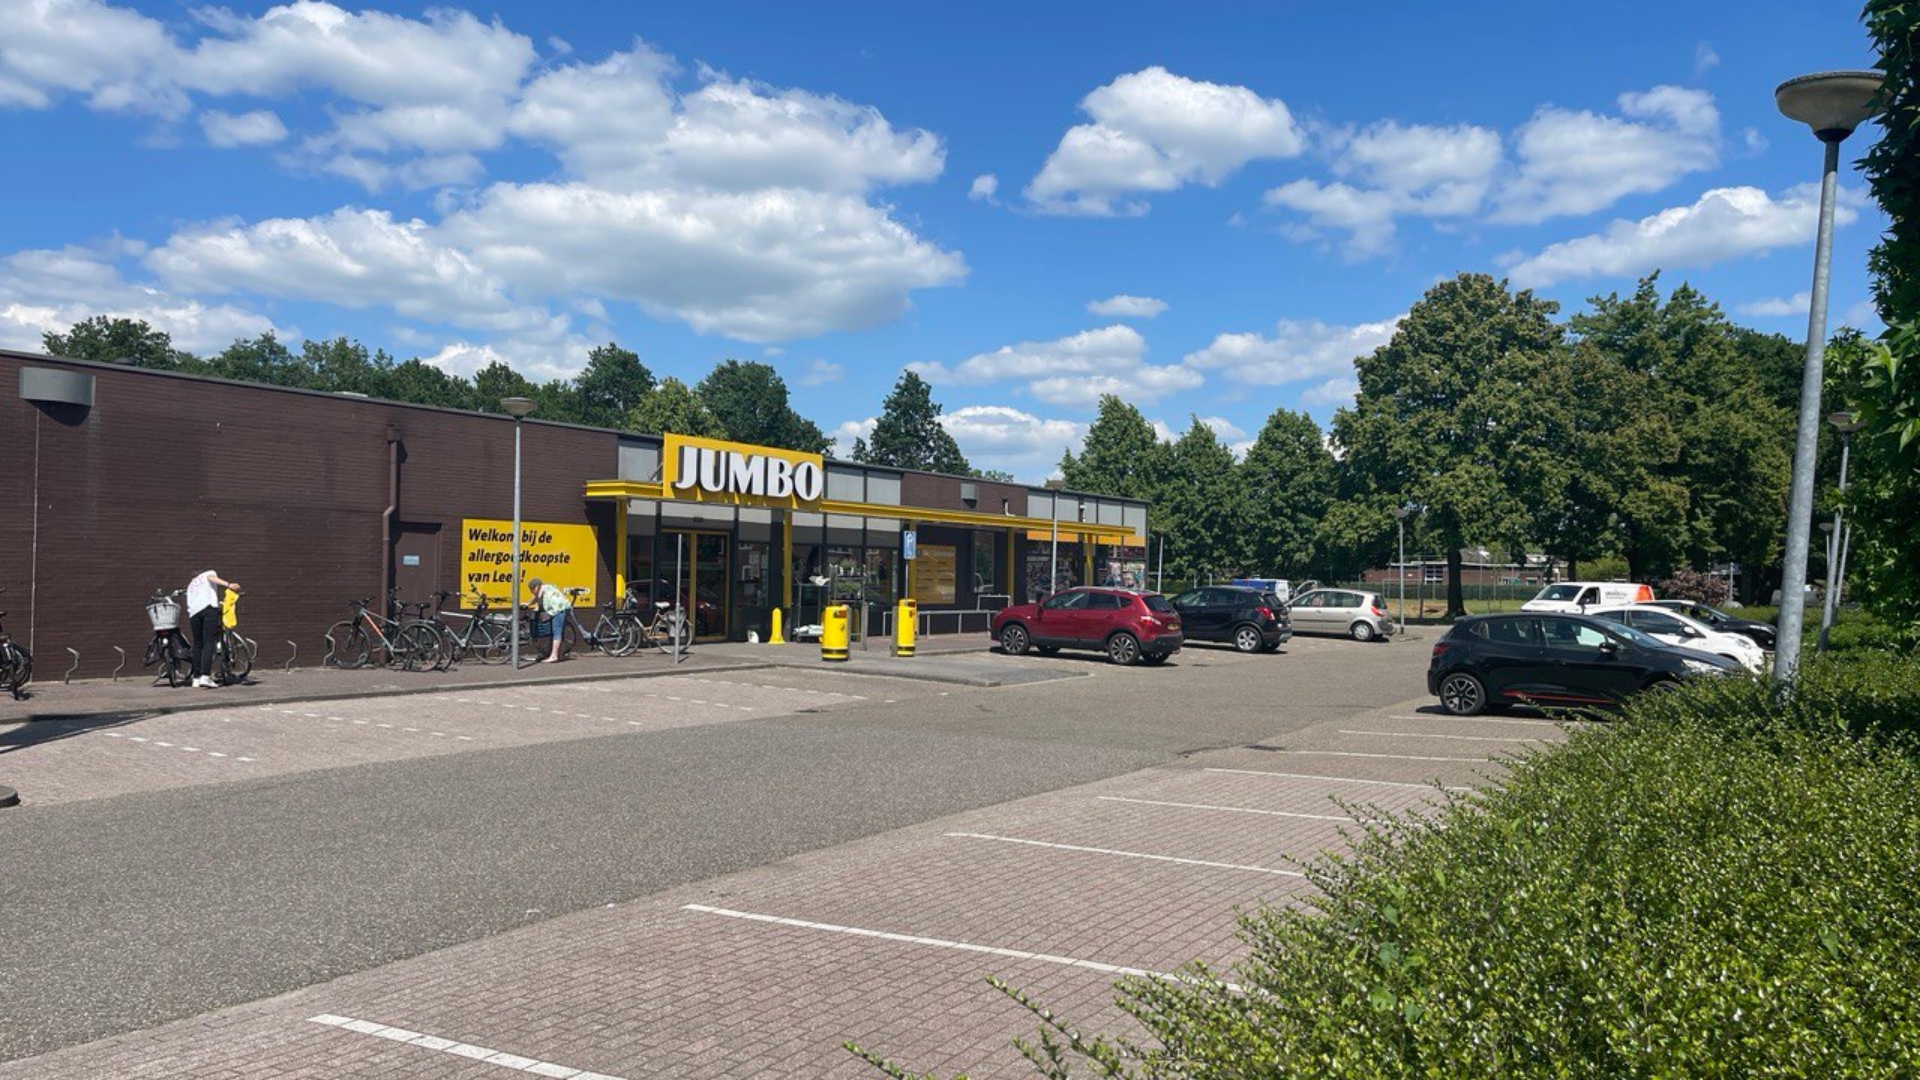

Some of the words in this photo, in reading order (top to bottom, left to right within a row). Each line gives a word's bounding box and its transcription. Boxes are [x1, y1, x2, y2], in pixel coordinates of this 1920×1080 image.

[675, 445, 823, 501] JUMBO
[521, 530, 537, 546] bij
[538, 531, 552, 544] de
[467, 572, 490, 583] van
[492, 570, 526, 583] Lee!
